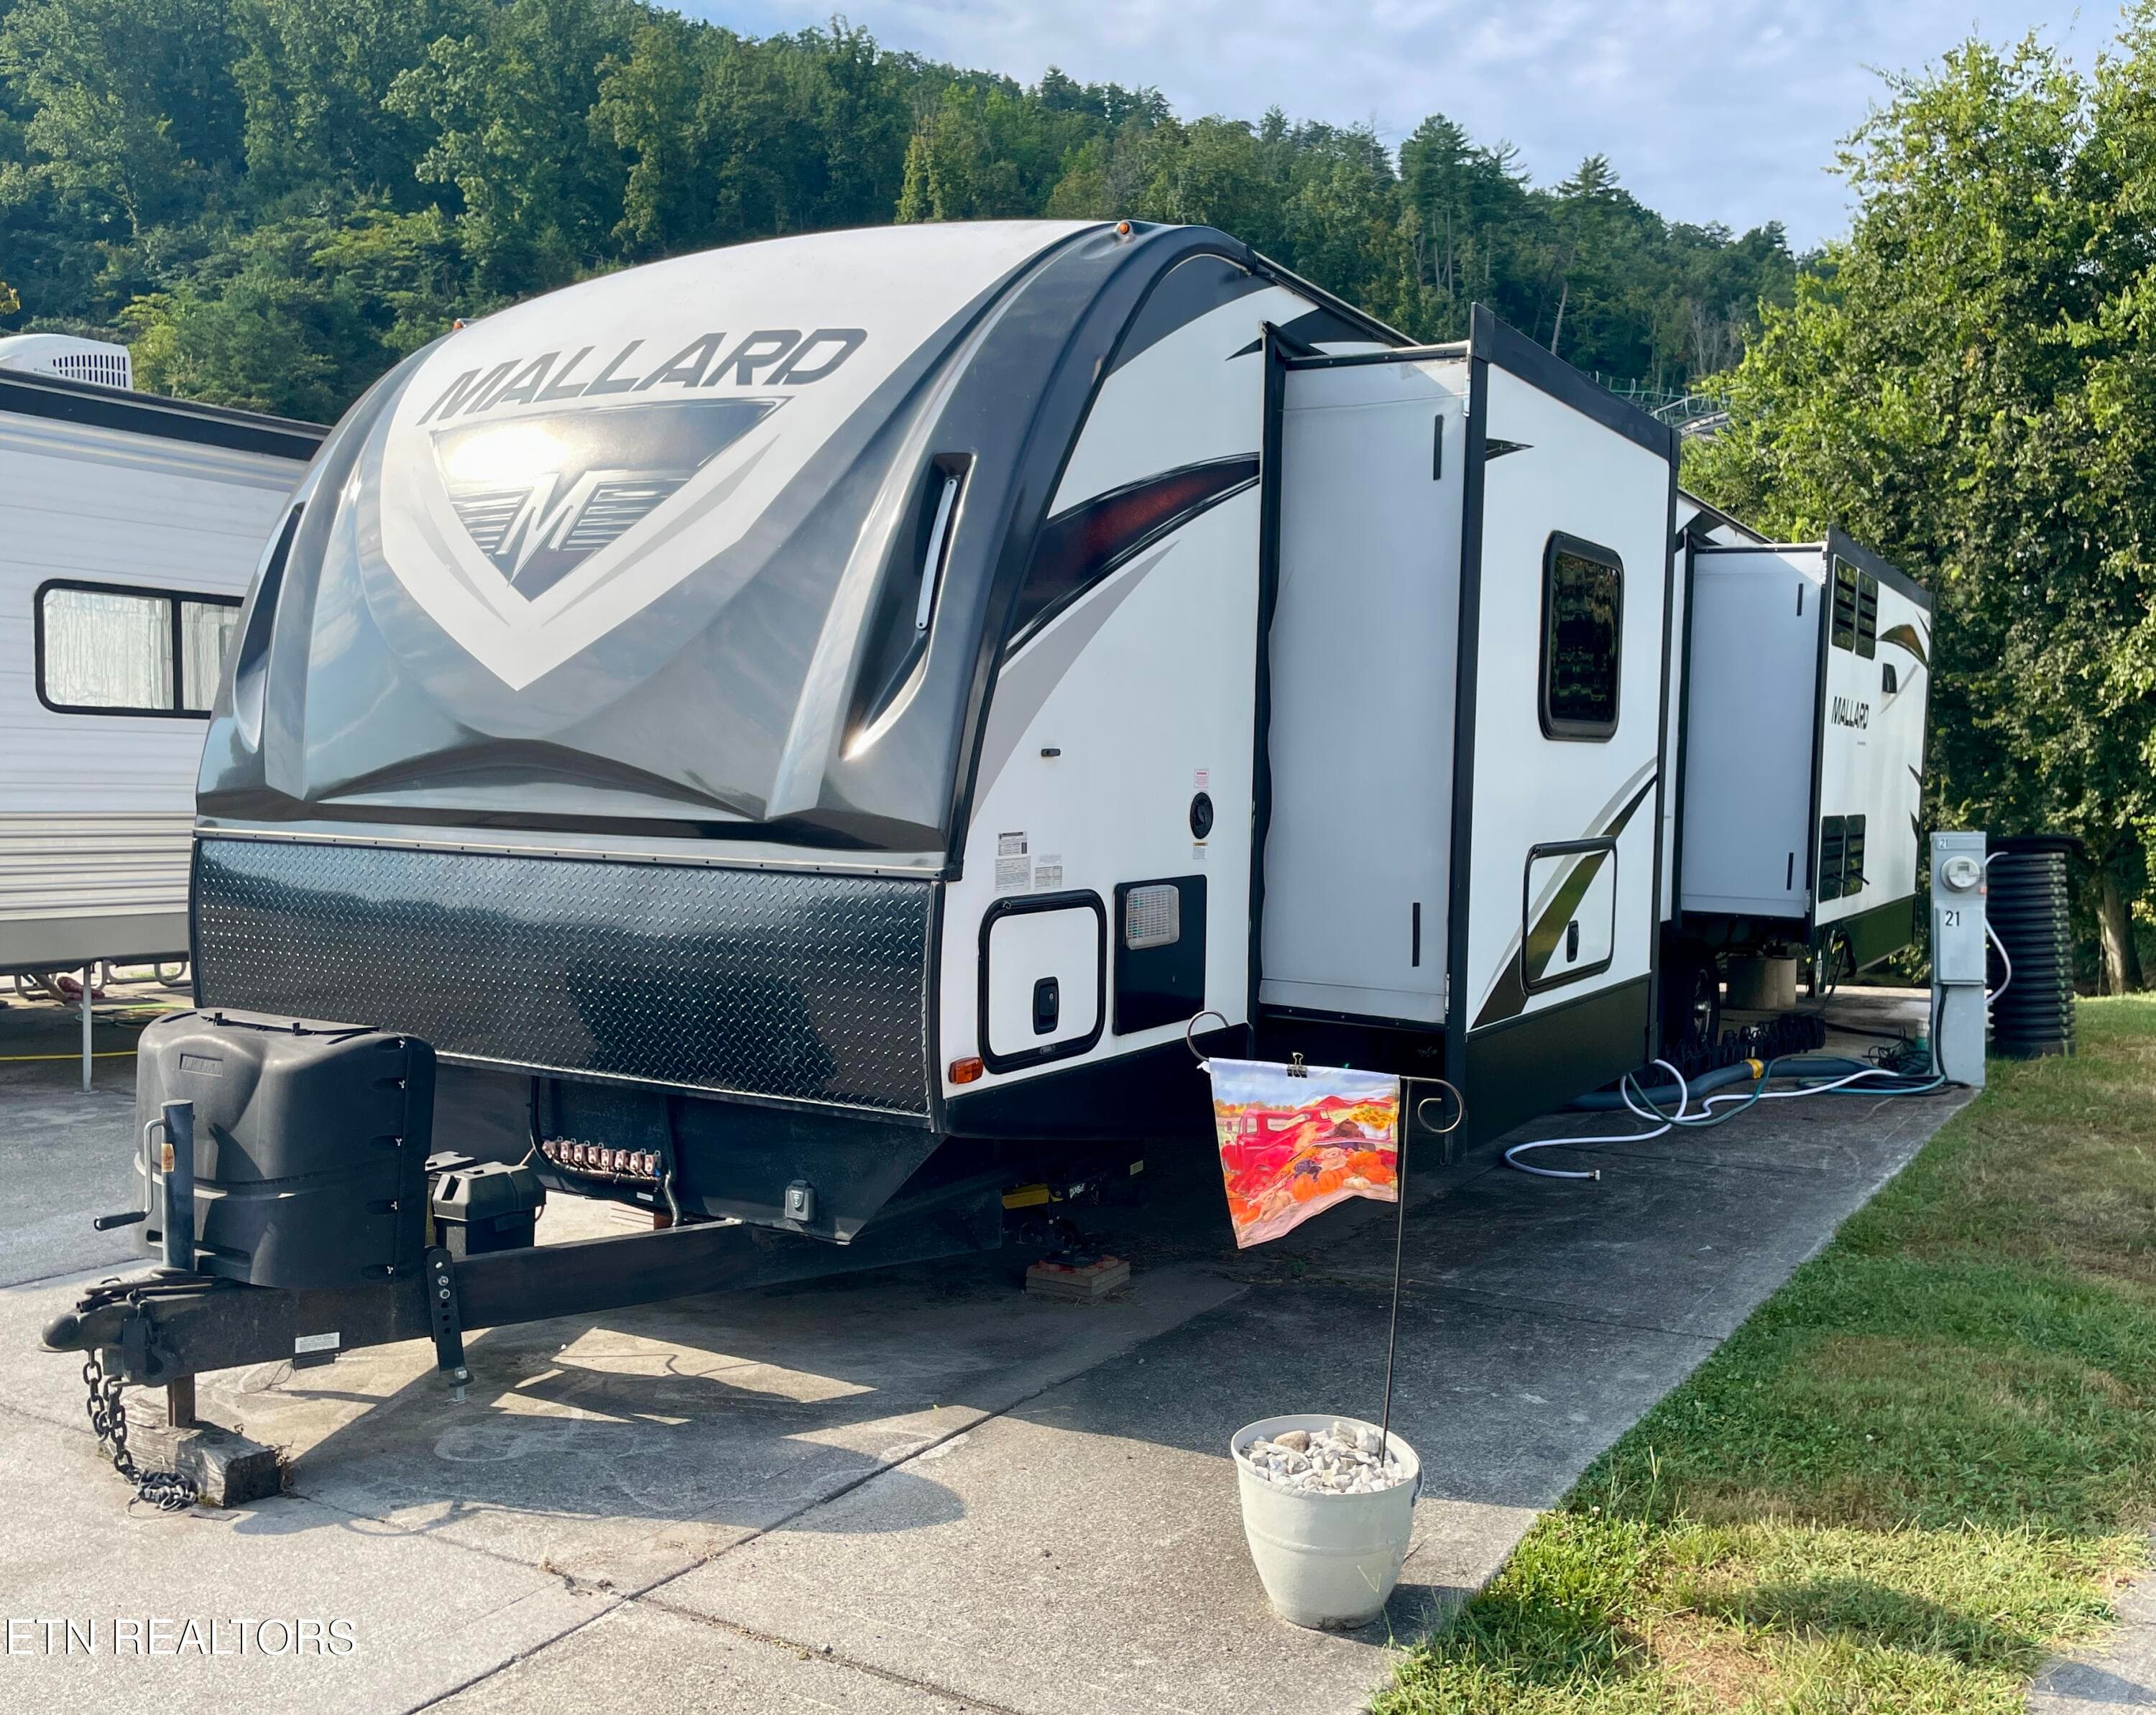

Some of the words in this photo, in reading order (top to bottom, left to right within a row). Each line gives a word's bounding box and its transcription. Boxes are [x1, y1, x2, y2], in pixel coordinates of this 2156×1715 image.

[415, 328, 868, 426] MALLARD
[1831, 695, 1869, 730] MALLARD
[1940, 838, 1948, 849] 21
[1945, 910, 1960, 927] 21
